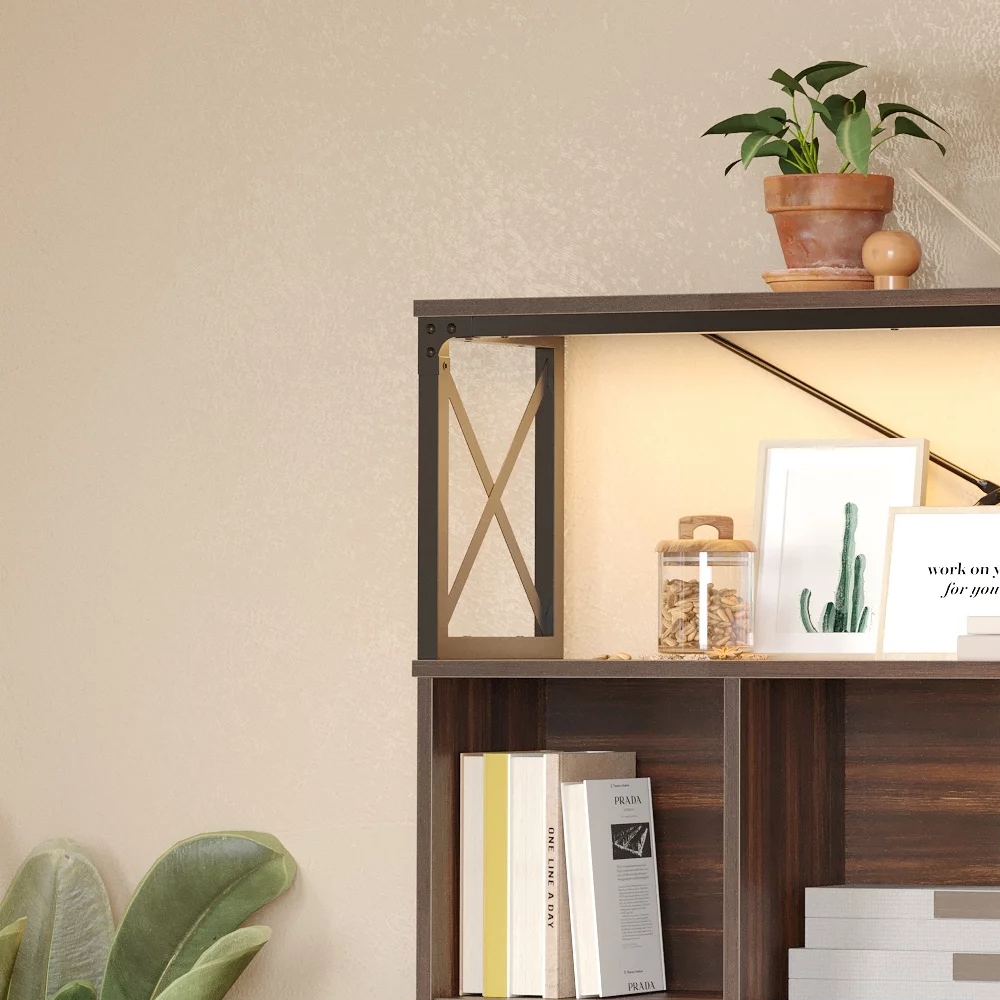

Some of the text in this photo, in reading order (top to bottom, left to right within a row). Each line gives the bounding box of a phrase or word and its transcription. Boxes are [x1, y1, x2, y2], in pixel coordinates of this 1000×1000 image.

[928, 562, 966, 575] work
[970, 566, 989, 575] on
[940, 581, 968, 598] for
[614, 795, 642, 805] PRADA
[548, 892, 555, 900] A
[628, 981, 656, 991] PRADA
